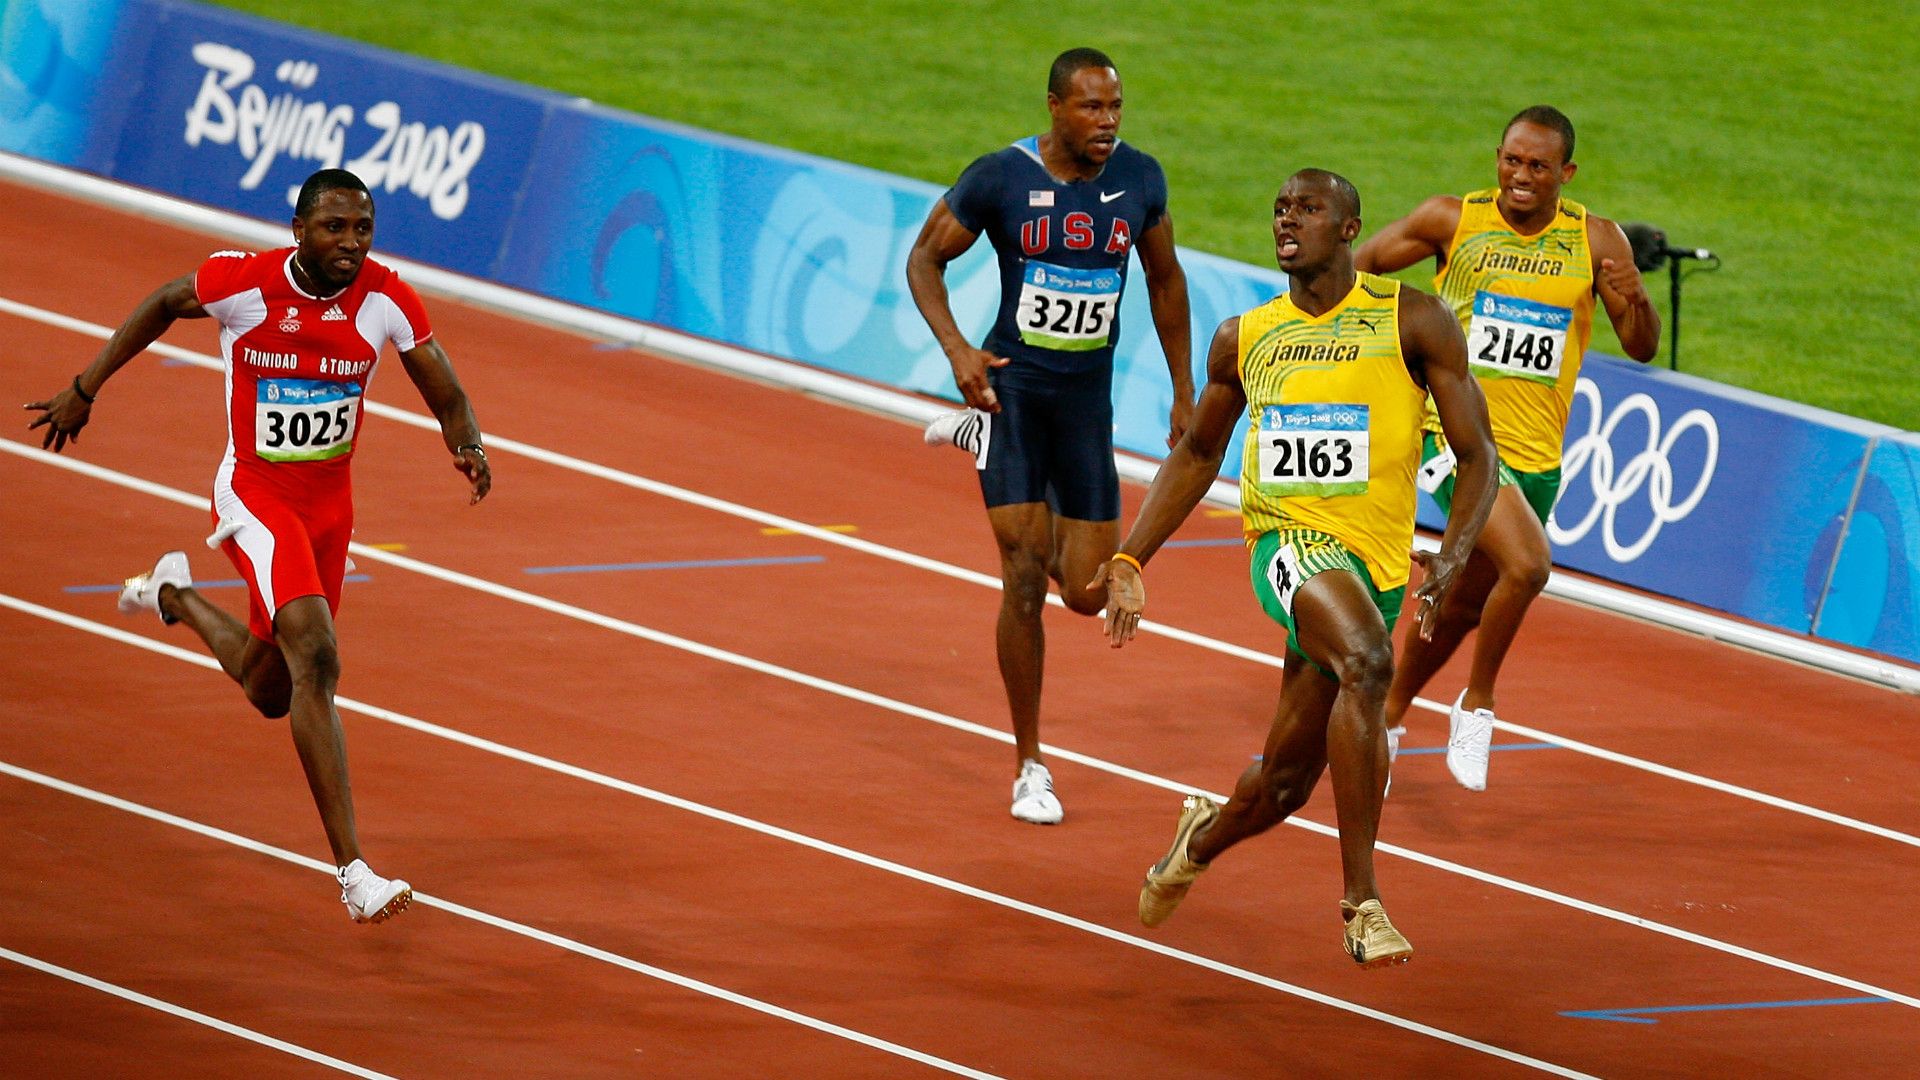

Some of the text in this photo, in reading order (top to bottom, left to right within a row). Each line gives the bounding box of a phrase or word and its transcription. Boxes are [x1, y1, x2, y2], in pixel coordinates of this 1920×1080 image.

[184, 42, 485, 220] Beijing 2008
[1020, 211, 1132, 257] USA
[1473, 245, 1563, 277] jamaica
[1028, 294, 1107, 335] 3215
[243, 346, 371, 376] TRINIDAD & TOBAGO
[1265, 339, 1361, 368] jamaica
[1477, 325, 1555, 371] 2148
[265, 404, 350, 449] 3025
[1271, 436, 1354, 478] 2163
[1275, 555, 1292, 600] 4
